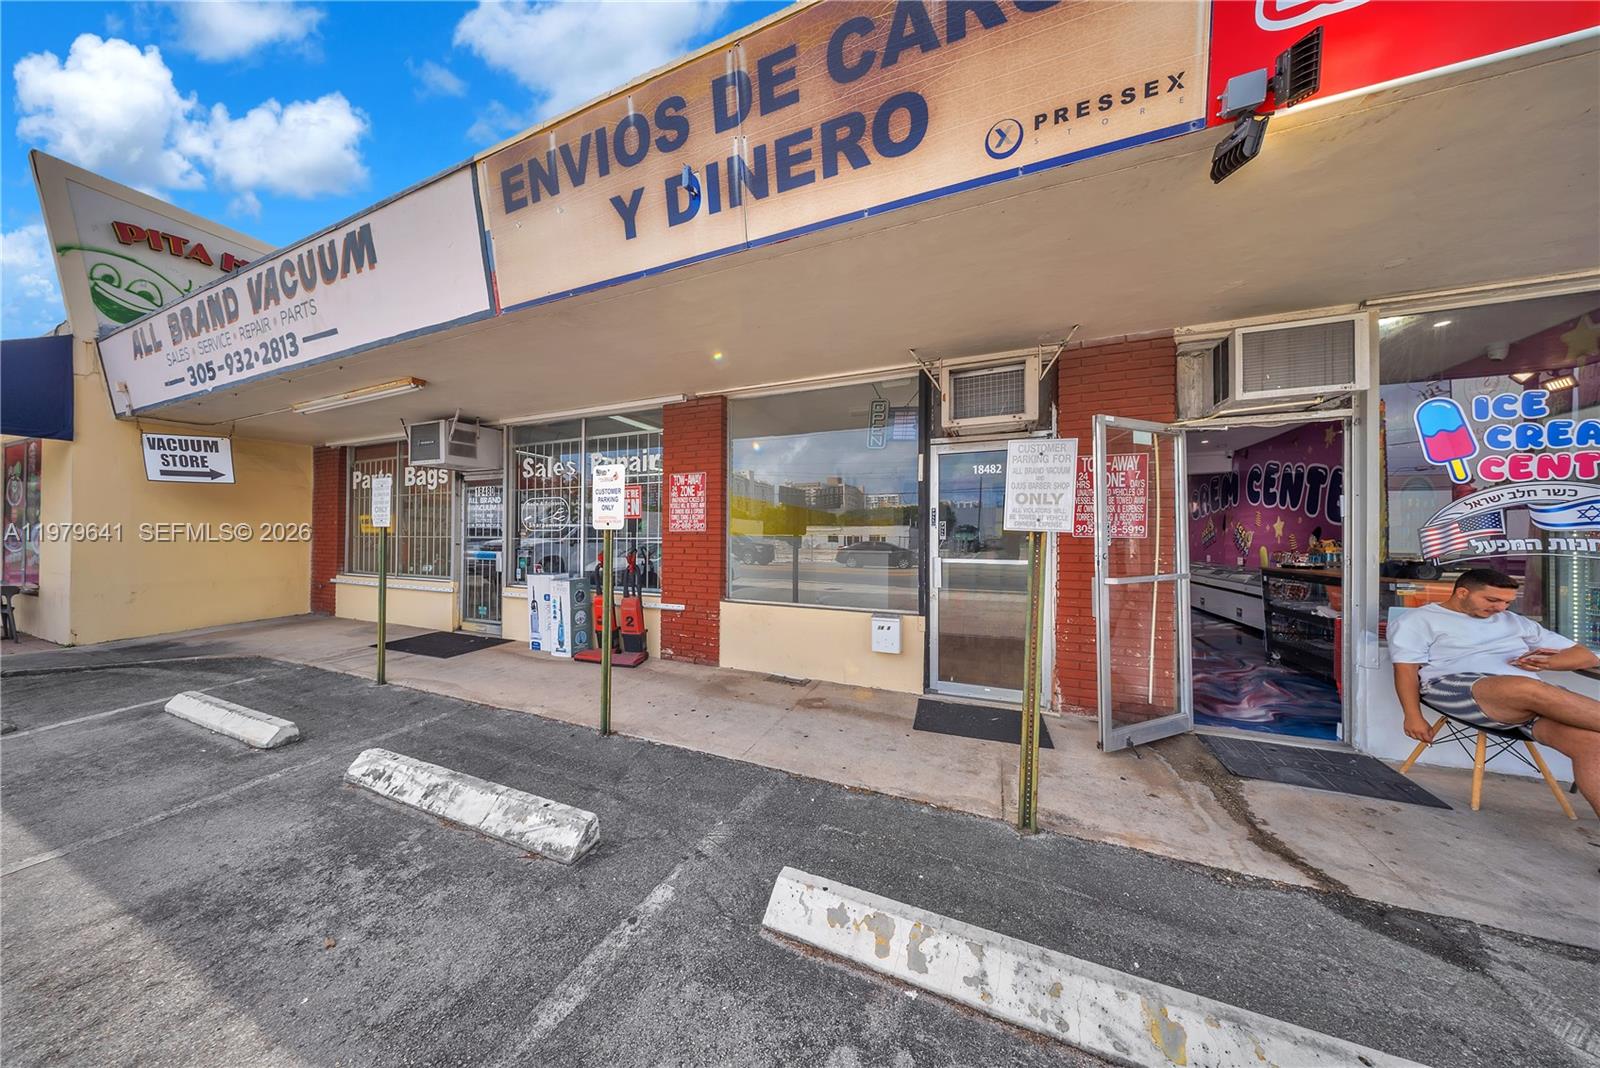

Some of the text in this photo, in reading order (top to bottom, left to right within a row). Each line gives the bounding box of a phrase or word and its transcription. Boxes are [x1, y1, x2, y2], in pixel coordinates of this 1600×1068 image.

[500, 0, 1063, 215] ENVIOS DE CAR
[1033, 71, 1186, 131] PRESSEX
[609, 91, 930, 241] Y DINERO
[111, 220, 215, 268] PITA
[131, 222, 378, 362] ALL BRAND VACUUM
[165, 298, 318, 367] SALES SERVICE REPAIR PARTS
[1472, 389, 1551, 422] ICE
[146, 436, 220, 453] VACUUM
[1018, 443, 1067, 454] CUSTOMER
[160, 453, 210, 468] STORE
[1012, 454, 1071, 464] PARKING FOR
[522, 456, 577, 479] Sales
[972, 463, 1003, 475] 18482
[1135, 471, 1141, 479] 7
[404, 466, 450, 490] Bags
[1076, 480, 1146, 489] HRS DAYS
[680, 485, 696, 497] ZONE
[1015, 492, 1065, 505] ONLY
[1463, 487, 1578, 511] כשר חלב ישראל
[479, 496, 502, 504] BRAND
[1468, 538, 1543, 554] המפעל
[626, 616, 635, 627] 2
